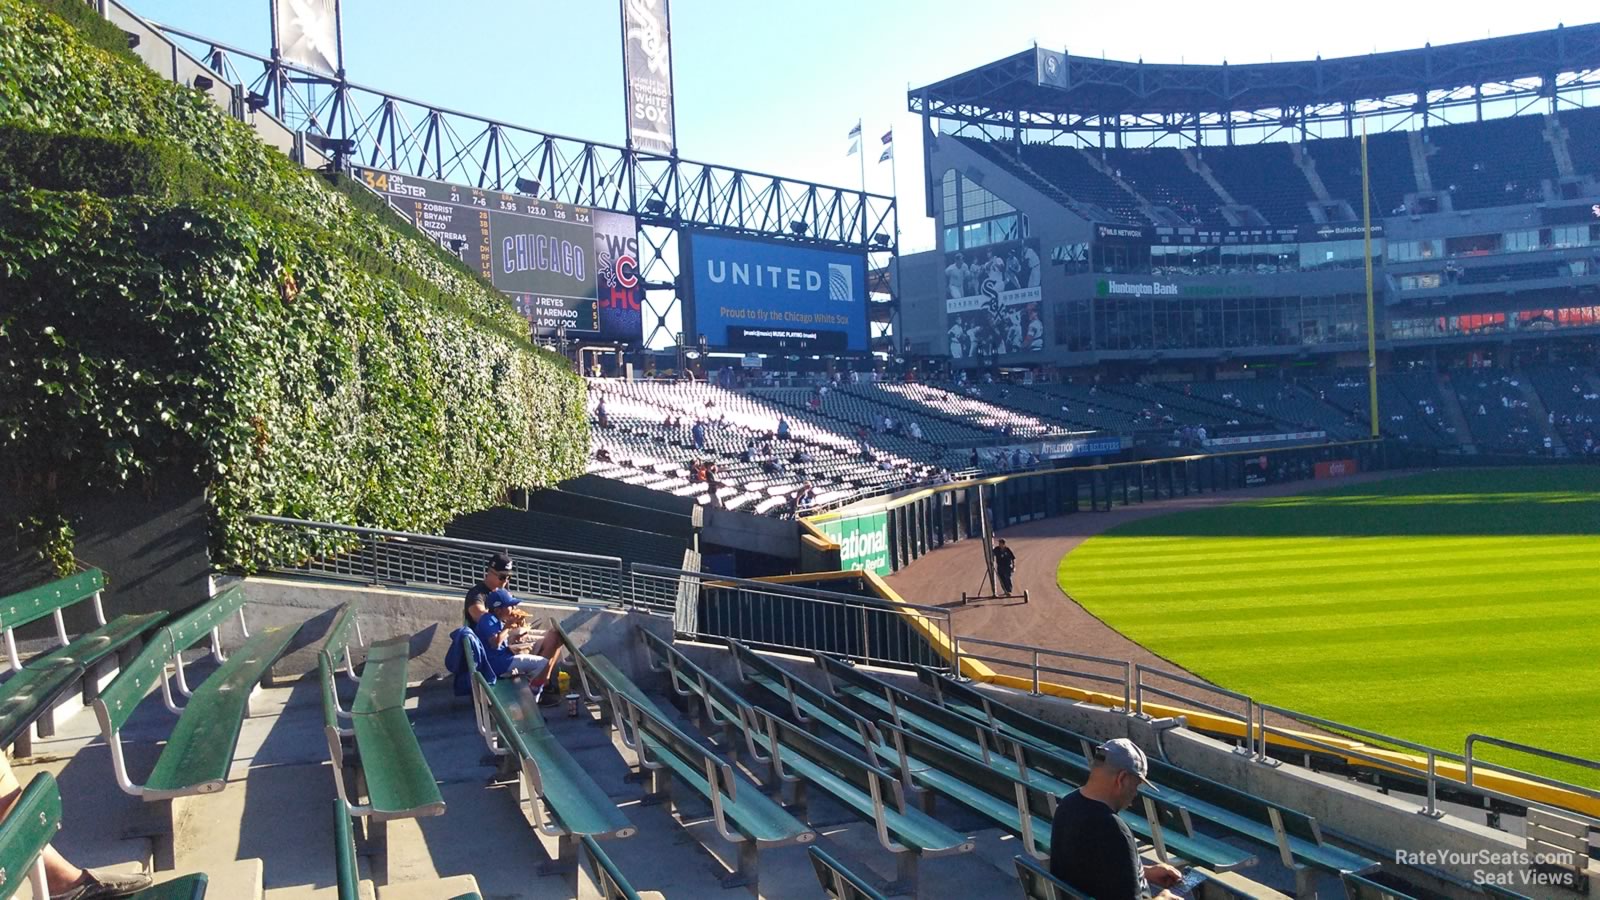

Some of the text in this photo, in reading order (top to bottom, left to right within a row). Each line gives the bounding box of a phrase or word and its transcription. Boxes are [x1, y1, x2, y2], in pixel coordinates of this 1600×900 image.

[634, 83, 667, 97] CHICAGO
[634, 92, 667, 108] WHITE
[634, 103, 667, 125] SOX
[364, 170, 388, 192] 34
[388, 174, 403, 184] JON
[388, 182, 426, 198] LESTER
[450, 193, 460, 202] 21
[472, 197, 487, 207] 7-6
[414, 202, 453, 214] 18 ZOBRIST
[500, 201, 517, 211] 3.95
[527, 205, 547, 216] 123.0
[424, 212, 452, 222] BRYANT
[554, 210, 566, 219] 126
[575, 213, 589, 223] 1.24
[424, 221, 446, 230] RIZZO
[1335, 226, 1383, 234] BullsSoxom
[1106, 228, 1142, 238] MLB NETWORK
[502, 233, 586, 282] CHICAGO
[615, 254, 639, 289] C
[707, 259, 822, 292] UNITED
[1108, 280, 1153, 297] Huntington
[1153, 282, 1178, 295] Bank
[535, 297, 540, 305] J
[541, 298, 564, 307] REYES
[536, 308, 542, 316] N
[543, 309, 578, 318] ARENADO
[720, 306, 849, 325] Proud to fly the Chicago White Sox
[537, 319, 543, 327] A
[1041, 442, 1074, 455] ATHLETICO
[865, 554, 886, 570] Rental
